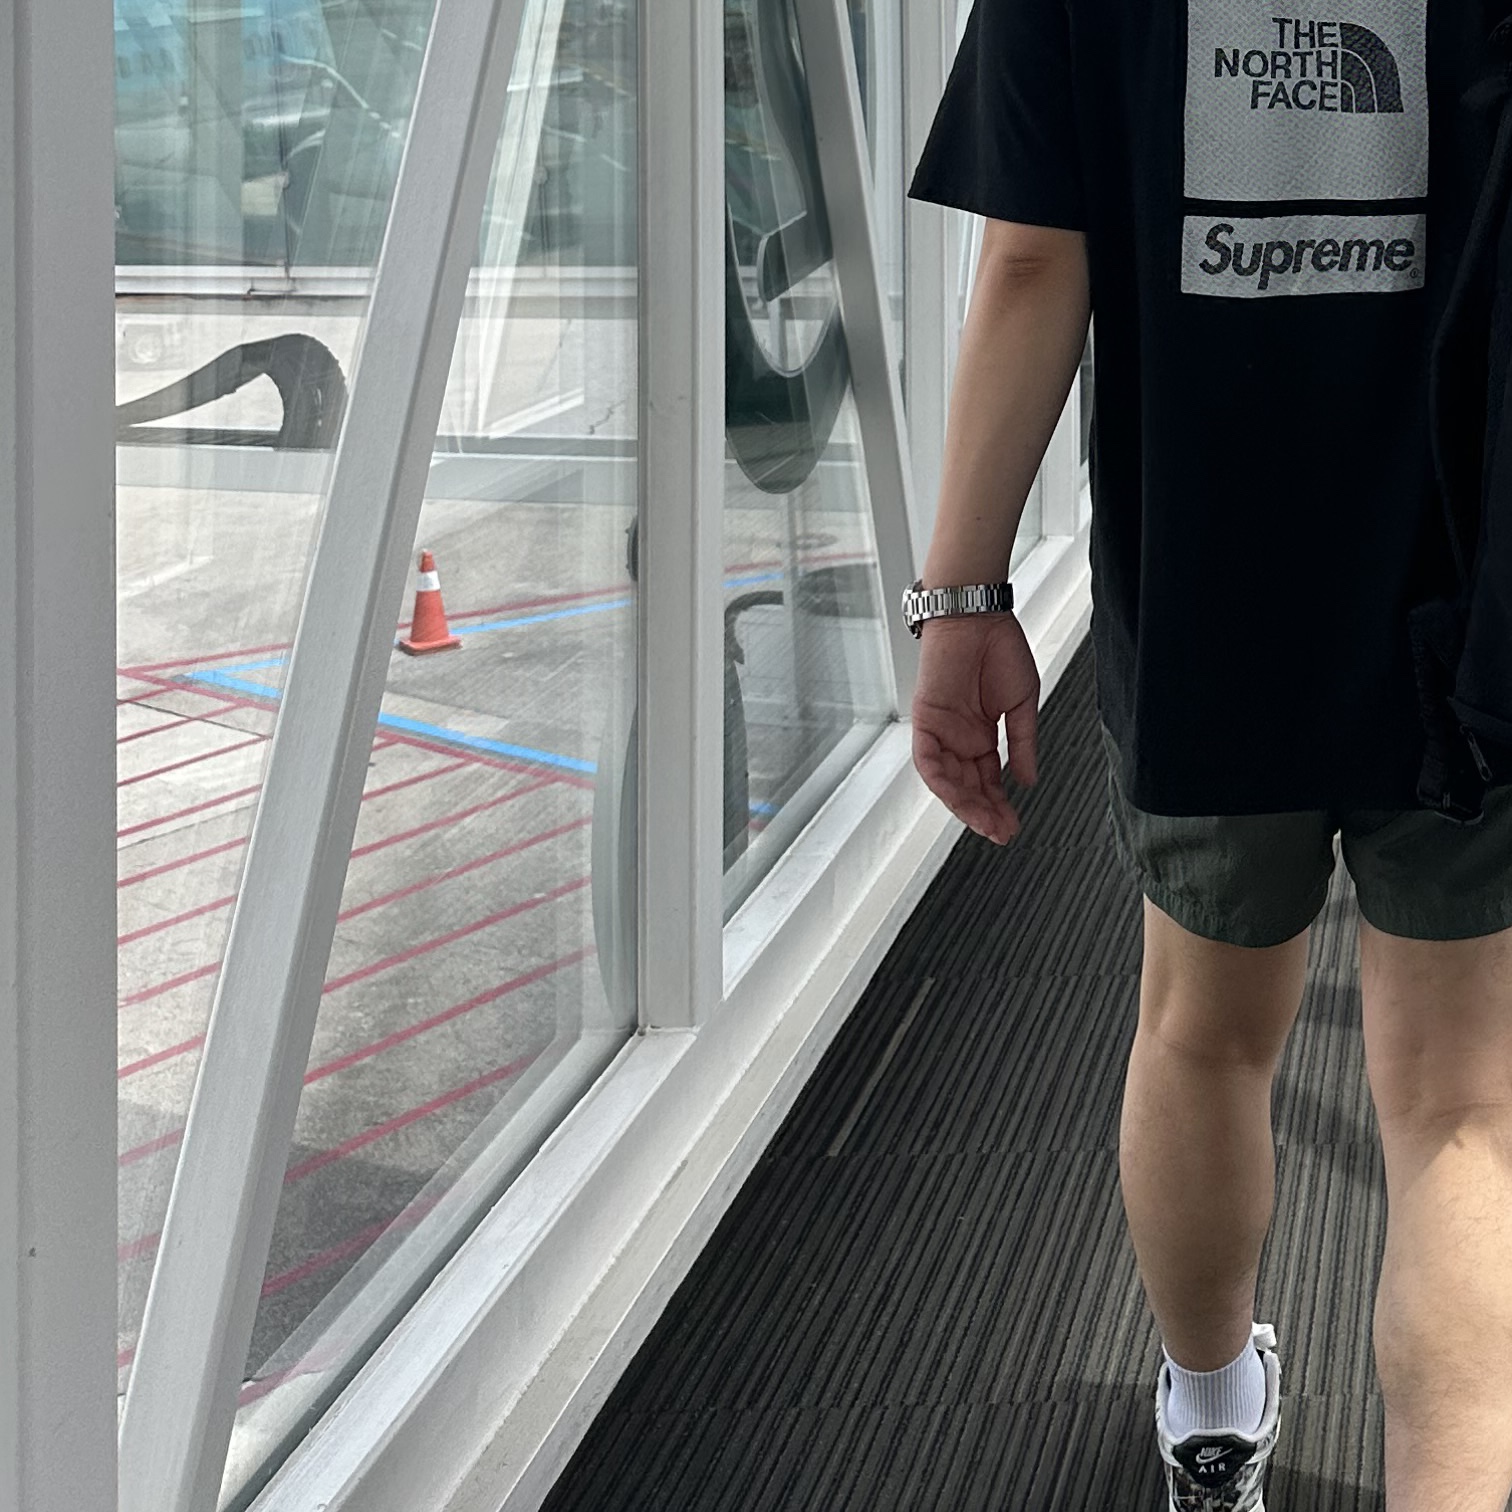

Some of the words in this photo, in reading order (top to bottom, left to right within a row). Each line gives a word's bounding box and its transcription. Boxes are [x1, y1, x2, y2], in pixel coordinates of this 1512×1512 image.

[1272, 17, 1337, 49] THE
[1214, 48, 1339, 80] NORTH
[1250, 79, 1338, 112] FACE
[1199, 222, 1415, 290] Supreme
[1199, 1463, 1226, 1473] AIR
